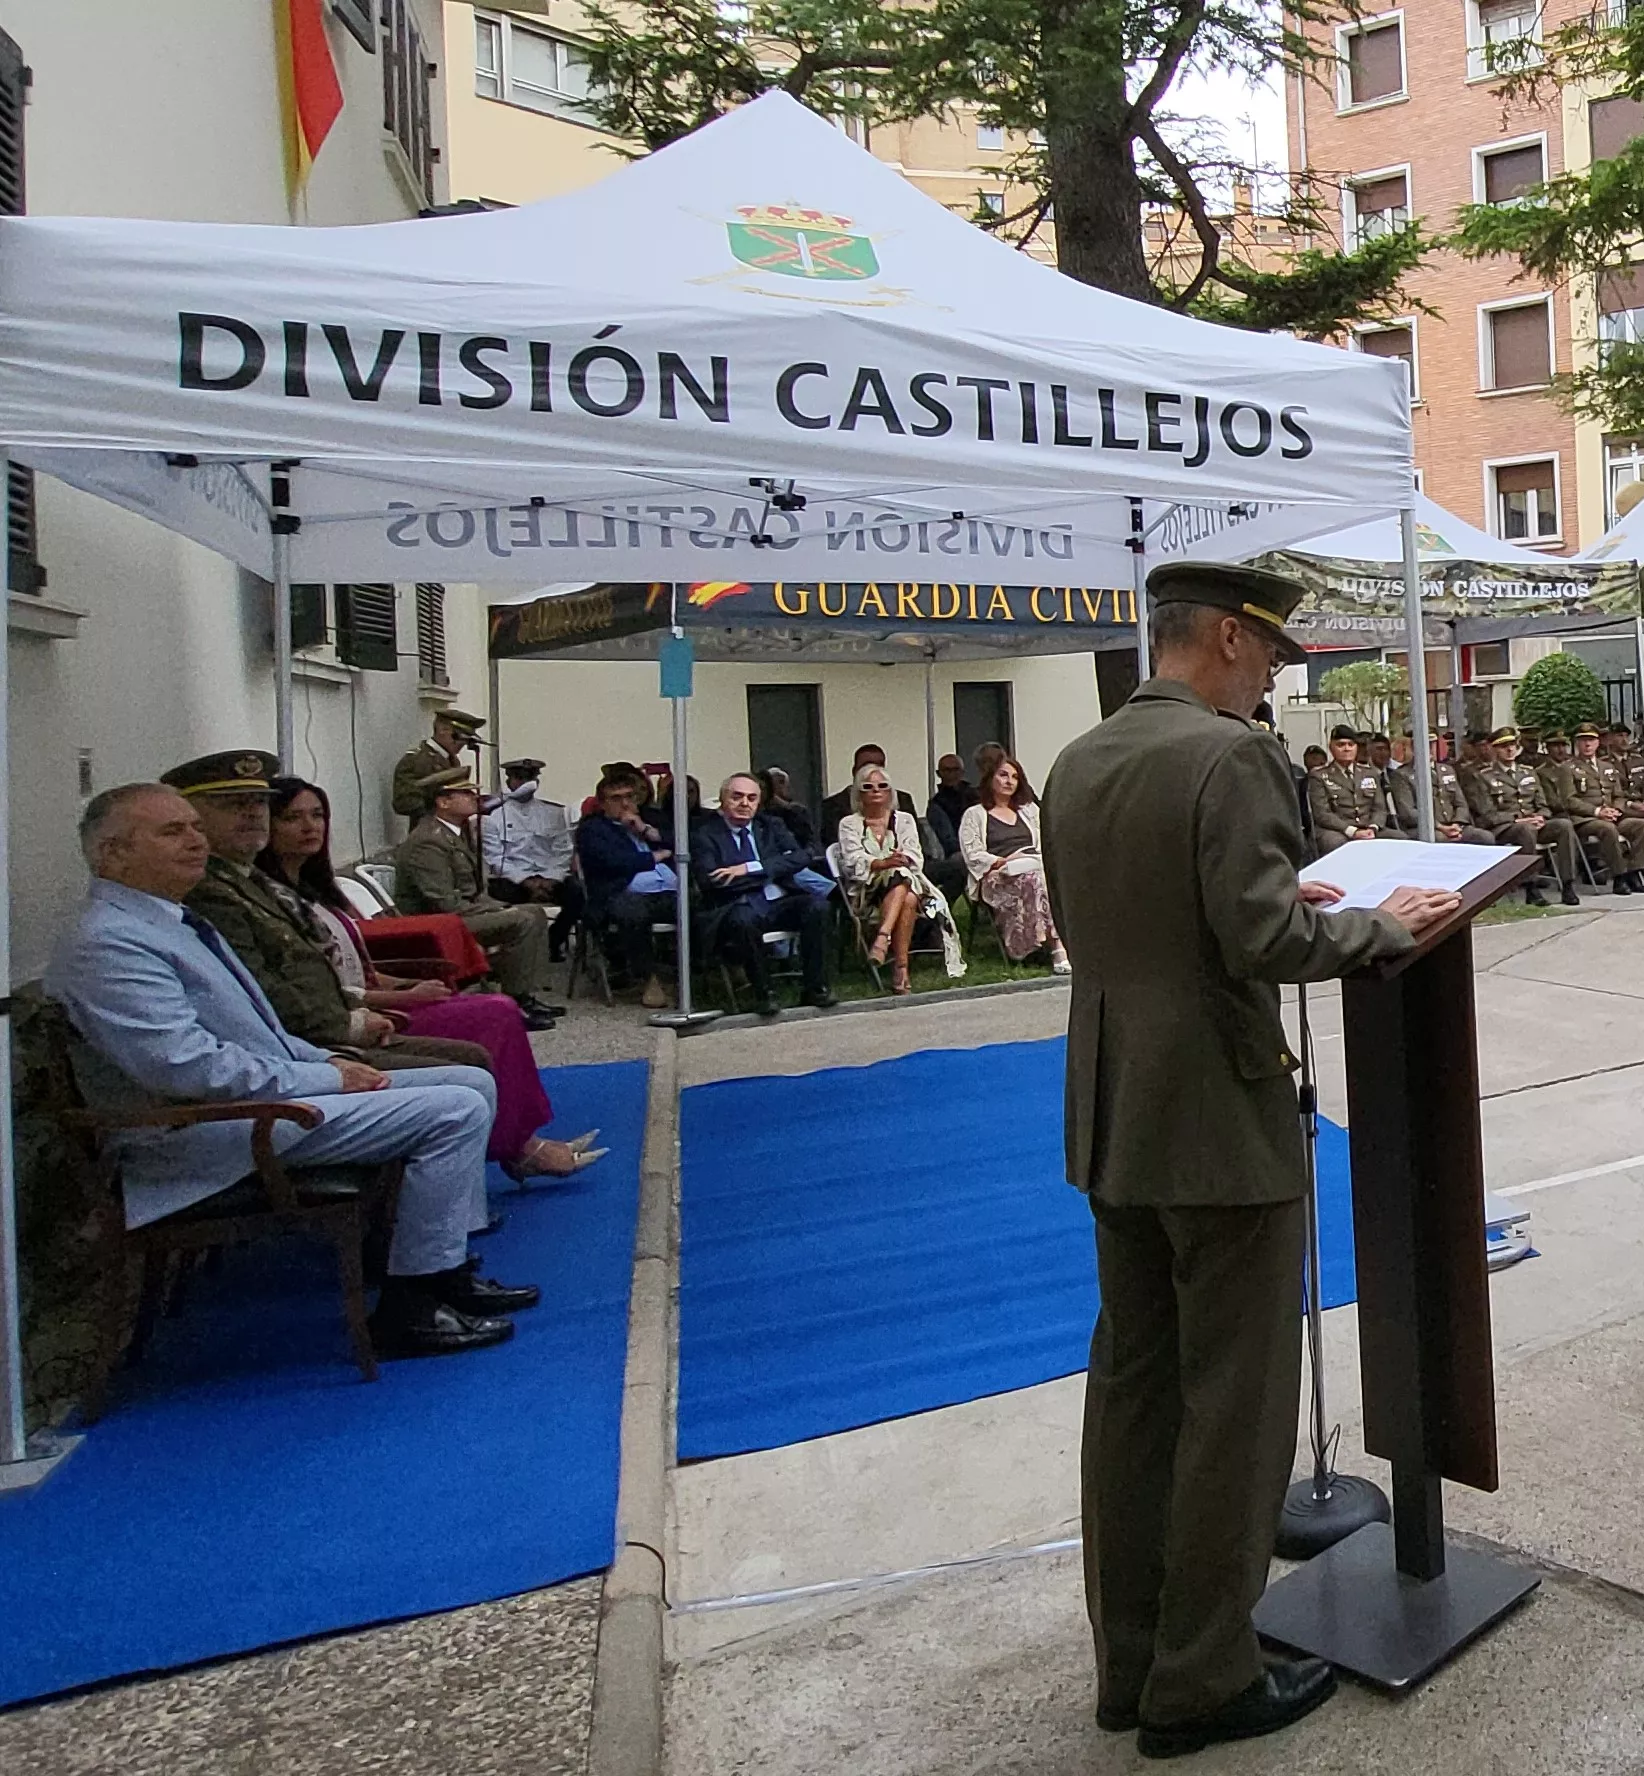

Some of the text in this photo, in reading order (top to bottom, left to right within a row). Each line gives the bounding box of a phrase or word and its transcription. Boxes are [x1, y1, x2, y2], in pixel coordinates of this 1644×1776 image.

[178, 311, 1315, 468] DIVISIÓN CASTILLEJOS
[773, 581, 1015, 621] GUARDIA
[1340, 575, 1590, 599] DIVISÓN CASTILLEJOS
